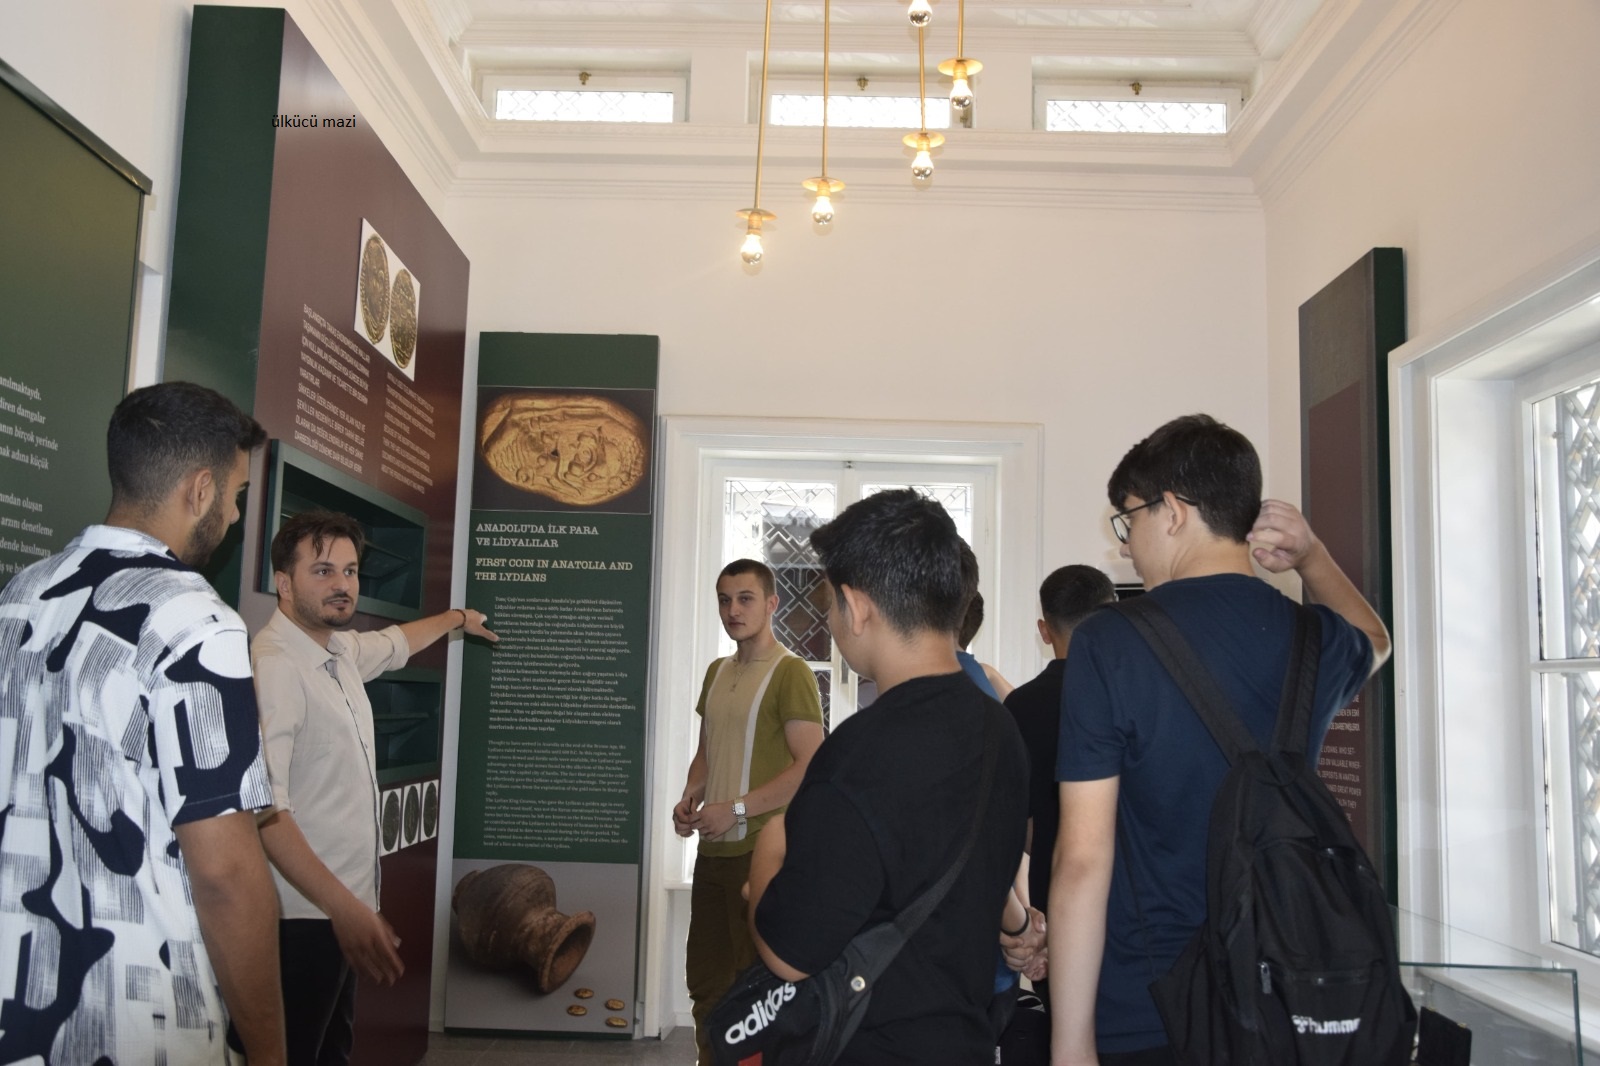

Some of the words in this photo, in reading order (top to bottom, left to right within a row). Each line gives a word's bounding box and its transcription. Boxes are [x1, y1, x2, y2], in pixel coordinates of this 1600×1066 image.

[17, 403, 46, 424] damgalar
[14, 425, 35, 444] birçok
[36, 434, 59, 451] yerinde
[11, 449, 29, 464] adına
[30, 452, 49, 470] küçük
[22, 497, 43, 512] oluşan
[21, 519, 53, 536] denetleme
[476, 523, 545, 534] ANADOLU'DA
[548, 523, 567, 535] İLK
[569, 526, 599, 535] PARA
[476, 537, 490, 546] VE
[492, 536, 559, 548] LİDYALILAR
[476, 557, 507, 567] FIRST
[508, 558, 534, 568] COIN
[537, 559, 549, 568] IN
[551, 559, 607, 570] ANATOLIA
[609, 561, 633, 571] AND
[475, 571, 497, 581] THE
[499, 572, 547, 582] LYDIANS
[724, 982, 797, 1045] adidas
